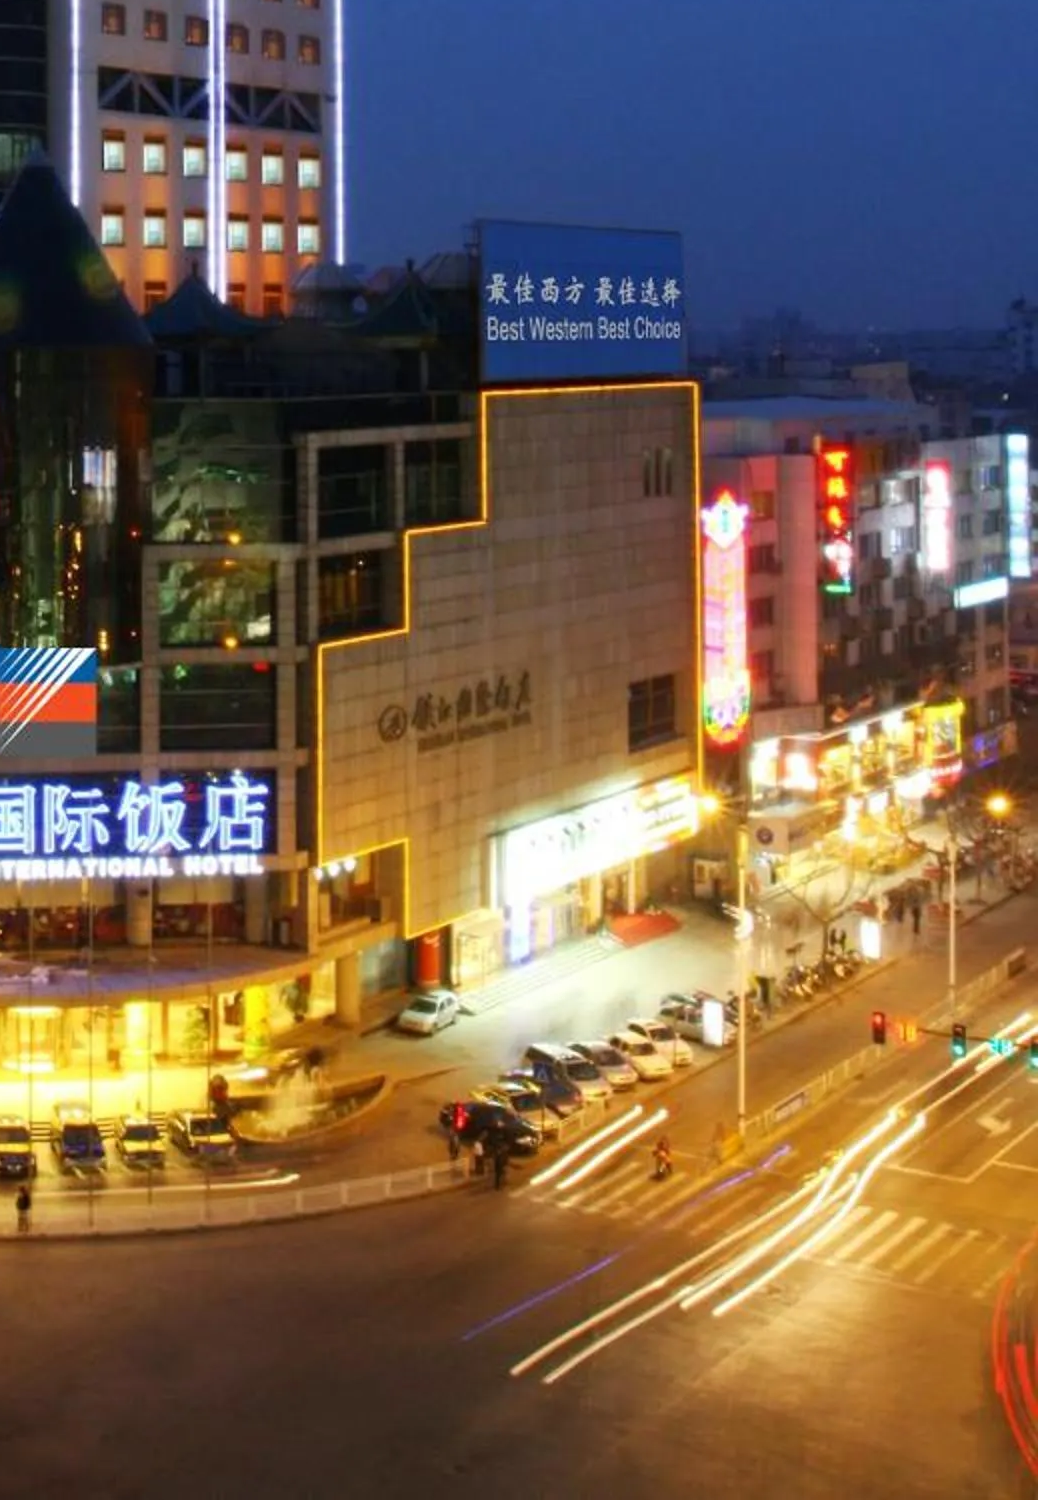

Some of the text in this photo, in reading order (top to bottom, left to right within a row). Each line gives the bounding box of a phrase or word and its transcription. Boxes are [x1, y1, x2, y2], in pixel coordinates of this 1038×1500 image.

[486, 272, 682, 309] 最佳西方 最佳选择
[487, 315, 681, 341] Best Western Best Choice
[182, 853, 265, 876] HOTEL
